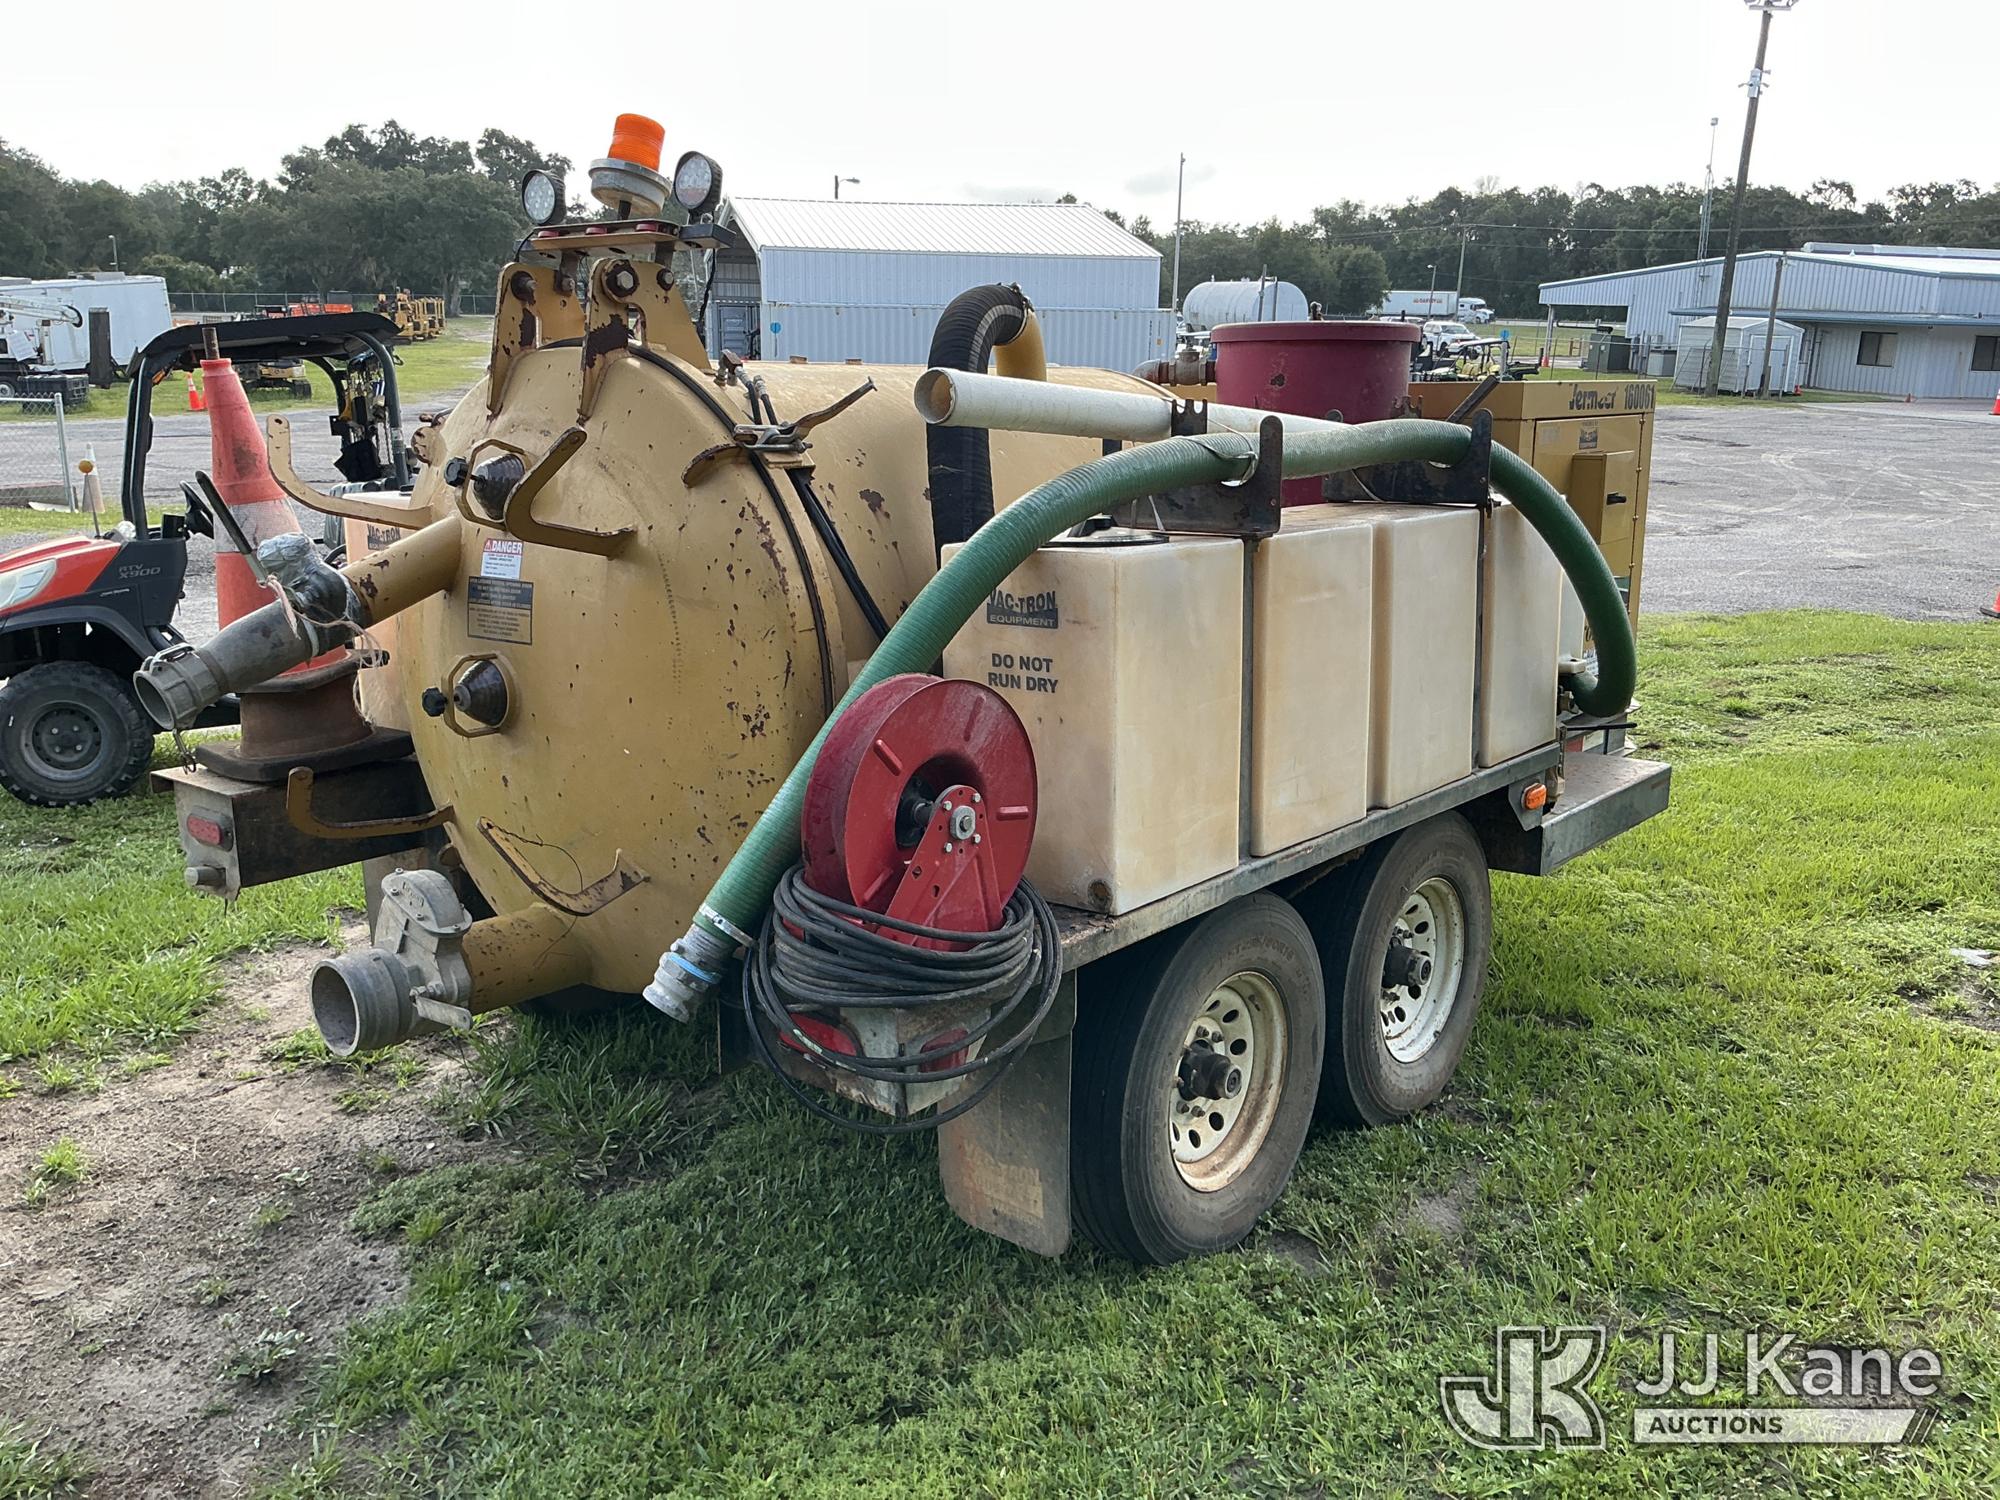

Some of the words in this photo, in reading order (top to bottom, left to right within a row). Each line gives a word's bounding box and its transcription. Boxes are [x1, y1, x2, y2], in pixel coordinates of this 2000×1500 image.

[491, 540, 523, 554] DANGER
[119, 563, 143, 573] RTV
[119, 566, 161, 579] X900
[988, 588, 1056, 613] VAC-TRON
[989, 614, 1056, 627] EQUIPMENT
[991, 653, 1015, 669] DO
[1019, 655, 1053, 673] NOT
[988, 672, 1021, 689] RUN
[1026, 675, 1058, 693] DRY
